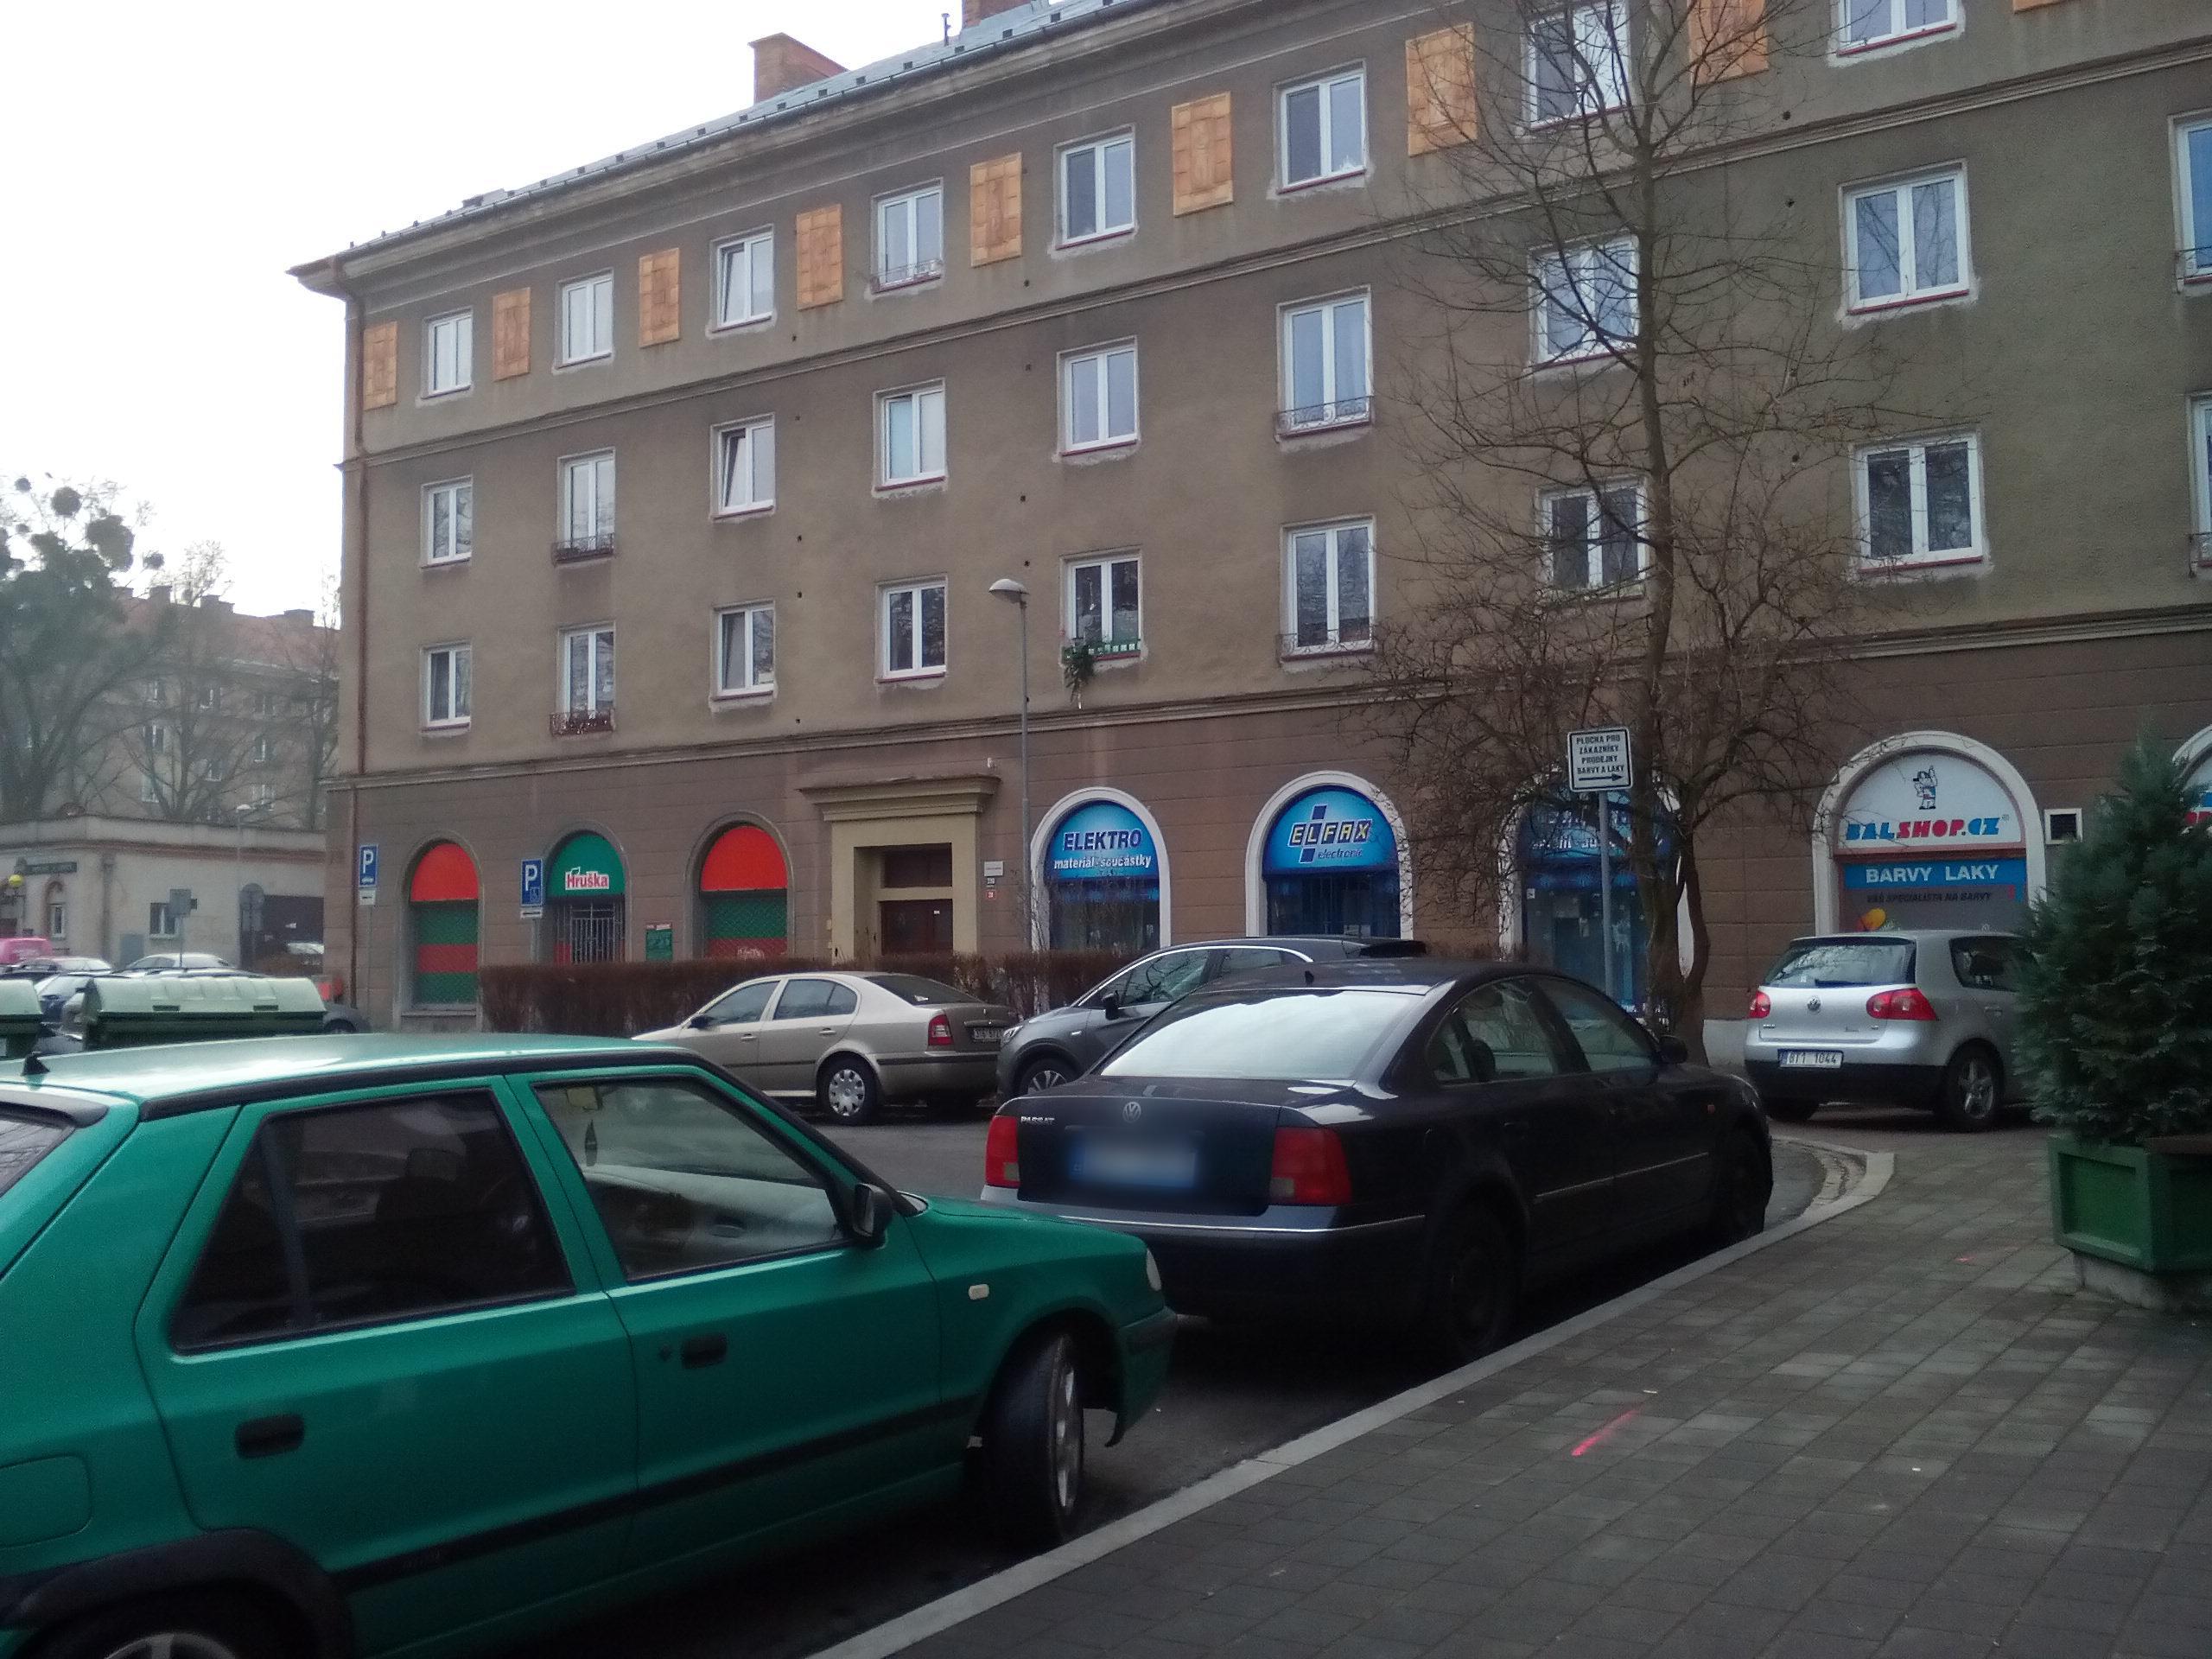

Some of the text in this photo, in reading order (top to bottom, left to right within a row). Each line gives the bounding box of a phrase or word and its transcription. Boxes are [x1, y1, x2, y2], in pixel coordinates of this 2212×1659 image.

[1576, 735, 1605, 744] PLOCHA
[1581, 755, 1618, 764] PRODEJNY
[1063, 829, 1142, 851] ELEKTRO
[1291, 822, 1370, 845] ELFAX
[363, 849, 374, 874] P
[1318, 848, 1363, 860] electronic
[525, 864, 538, 892] P
[567, 872, 608, 888] Hruška
[1866, 864, 1999, 884] BARVY LAKY
